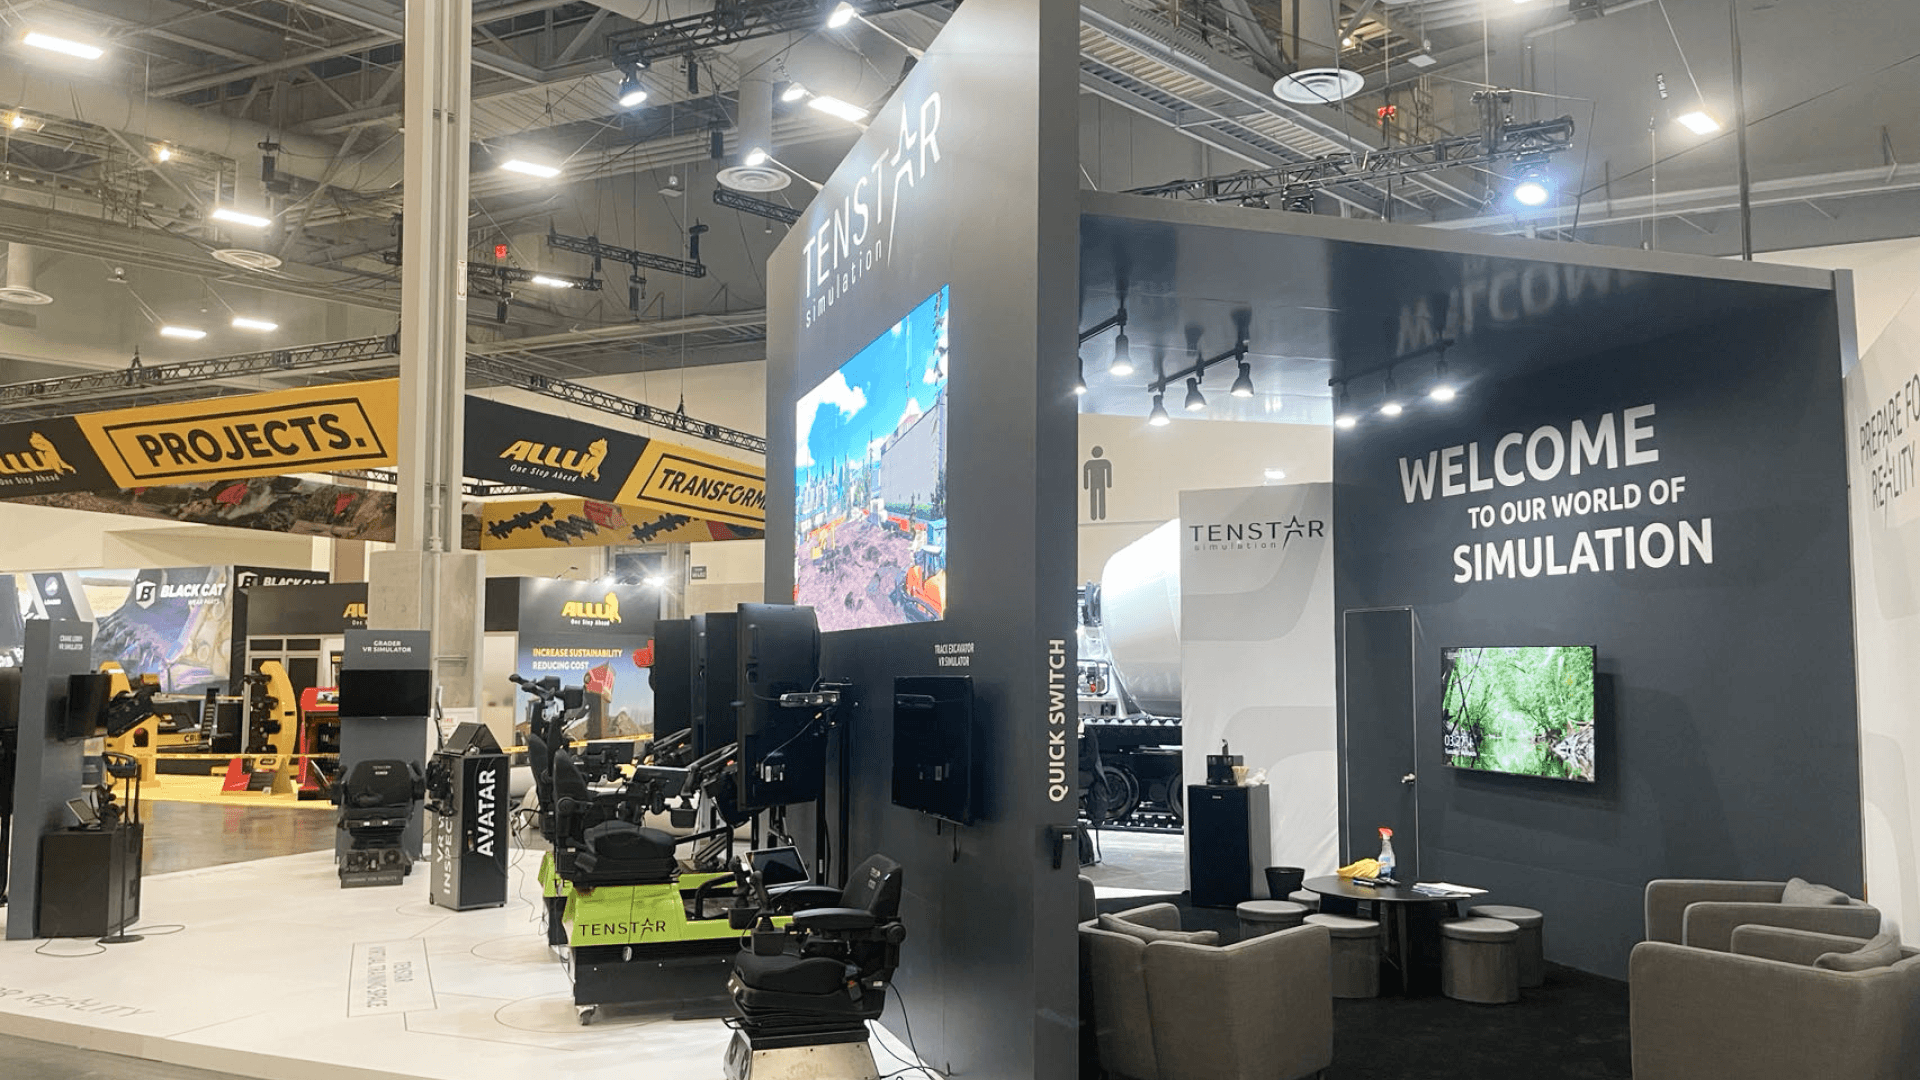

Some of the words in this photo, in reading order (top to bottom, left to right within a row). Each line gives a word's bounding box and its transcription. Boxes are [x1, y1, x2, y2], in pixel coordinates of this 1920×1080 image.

[803, 92, 941, 298] TENSTAR
[806, 239, 882, 329] simulation
[135, 413, 368, 468] PROJECTS.
[1860, 391, 1902, 465] PREPARE
[1905, 373, 1920, 428] FO
[509, 463, 528, 474] One
[529, 467, 550, 479] Step
[551, 472, 579, 483] Ahead
[1399, 404, 1660, 503] WELCOME
[1468, 505, 1496, 530] TO
[1500, 497, 1547, 525] OUR
[1551, 483, 1642, 520] WORLD
[1648, 476, 1687, 507] OF
[1872, 440, 1915, 530] REALITY
[1188, 515, 1325, 551] TENSTAR
[1194, 542, 1277, 552] simulation
[1453, 517, 1714, 585] SIMULATION
[160, 584, 201, 598] BLACK
[200, 583, 227, 597] CAT
[373, 646, 412, 654] SIMULATOR
[532, 648, 569, 658] INCREASE
[569, 648, 623, 658] SUSTAINABILITY
[532, 660, 570, 671] REDUCING
[570, 660, 589, 670] COST
[1048, 639, 1066, 725] SWITCH
[1048, 729, 1069, 802] QUICK
[476, 768, 497, 858] AVATAR
[436, 834, 445, 863] VR
[443, 818, 454, 895] INSPEC
[578, 918, 667, 939] TENSTAR
